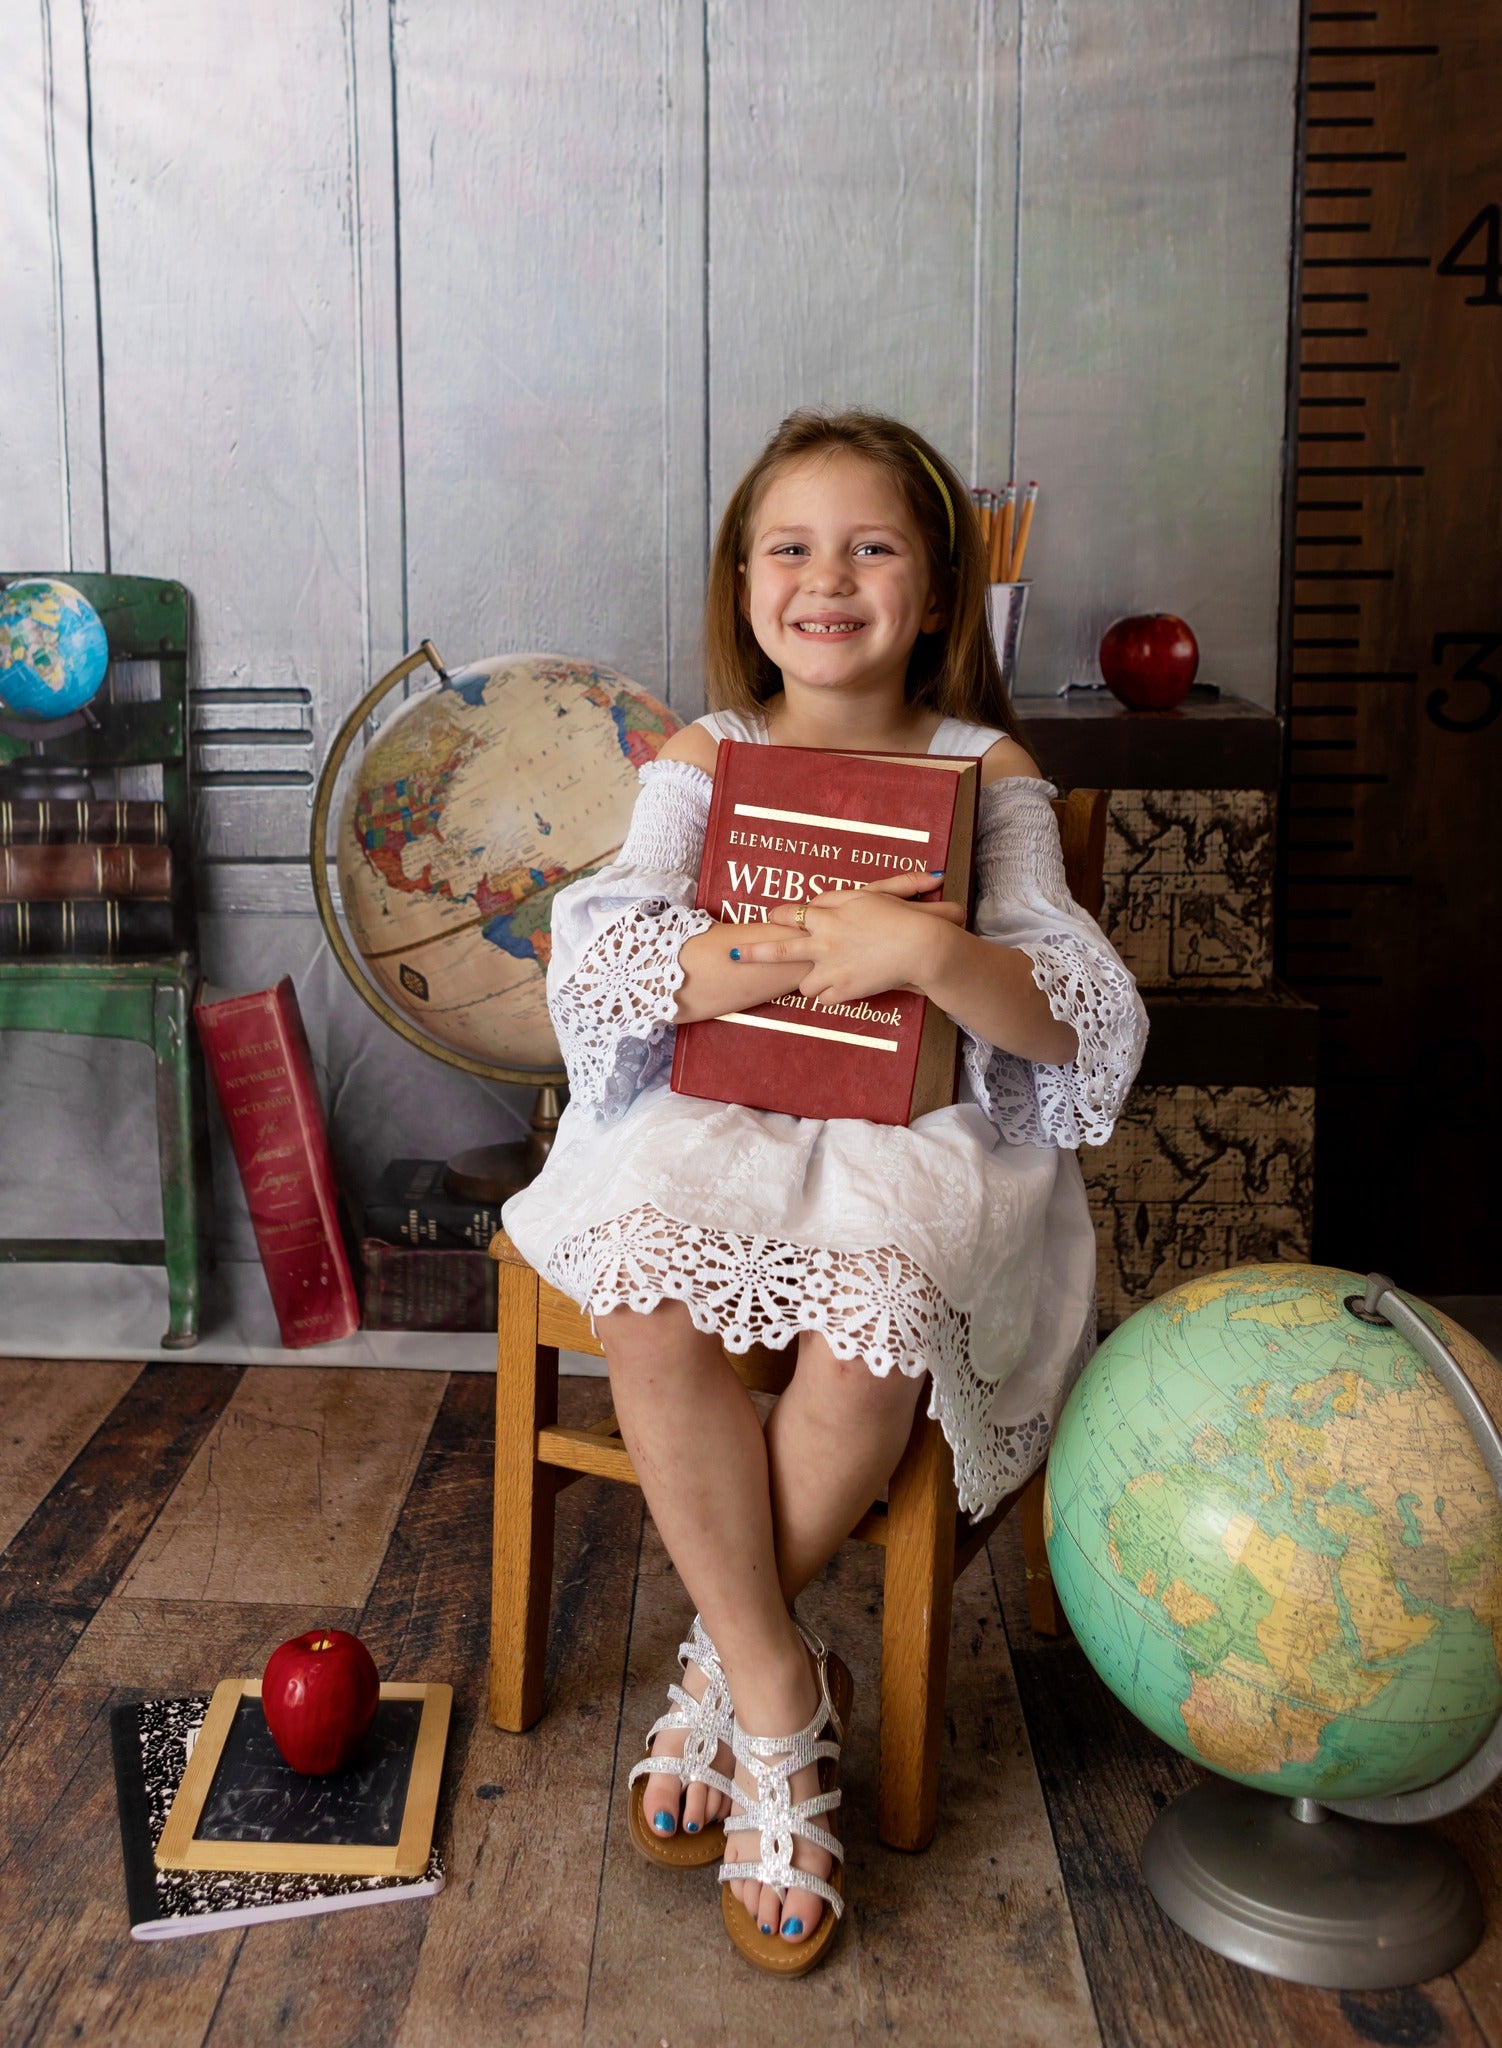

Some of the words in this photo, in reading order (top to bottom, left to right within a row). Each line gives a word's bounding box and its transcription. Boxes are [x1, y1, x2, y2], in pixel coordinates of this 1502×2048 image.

[1436, 204, 1502, 306] 4
[1425, 632, 1502, 733] 3
[729, 830, 842, 861] ELEMENTARY
[850, 849, 928, 873] EDITION
